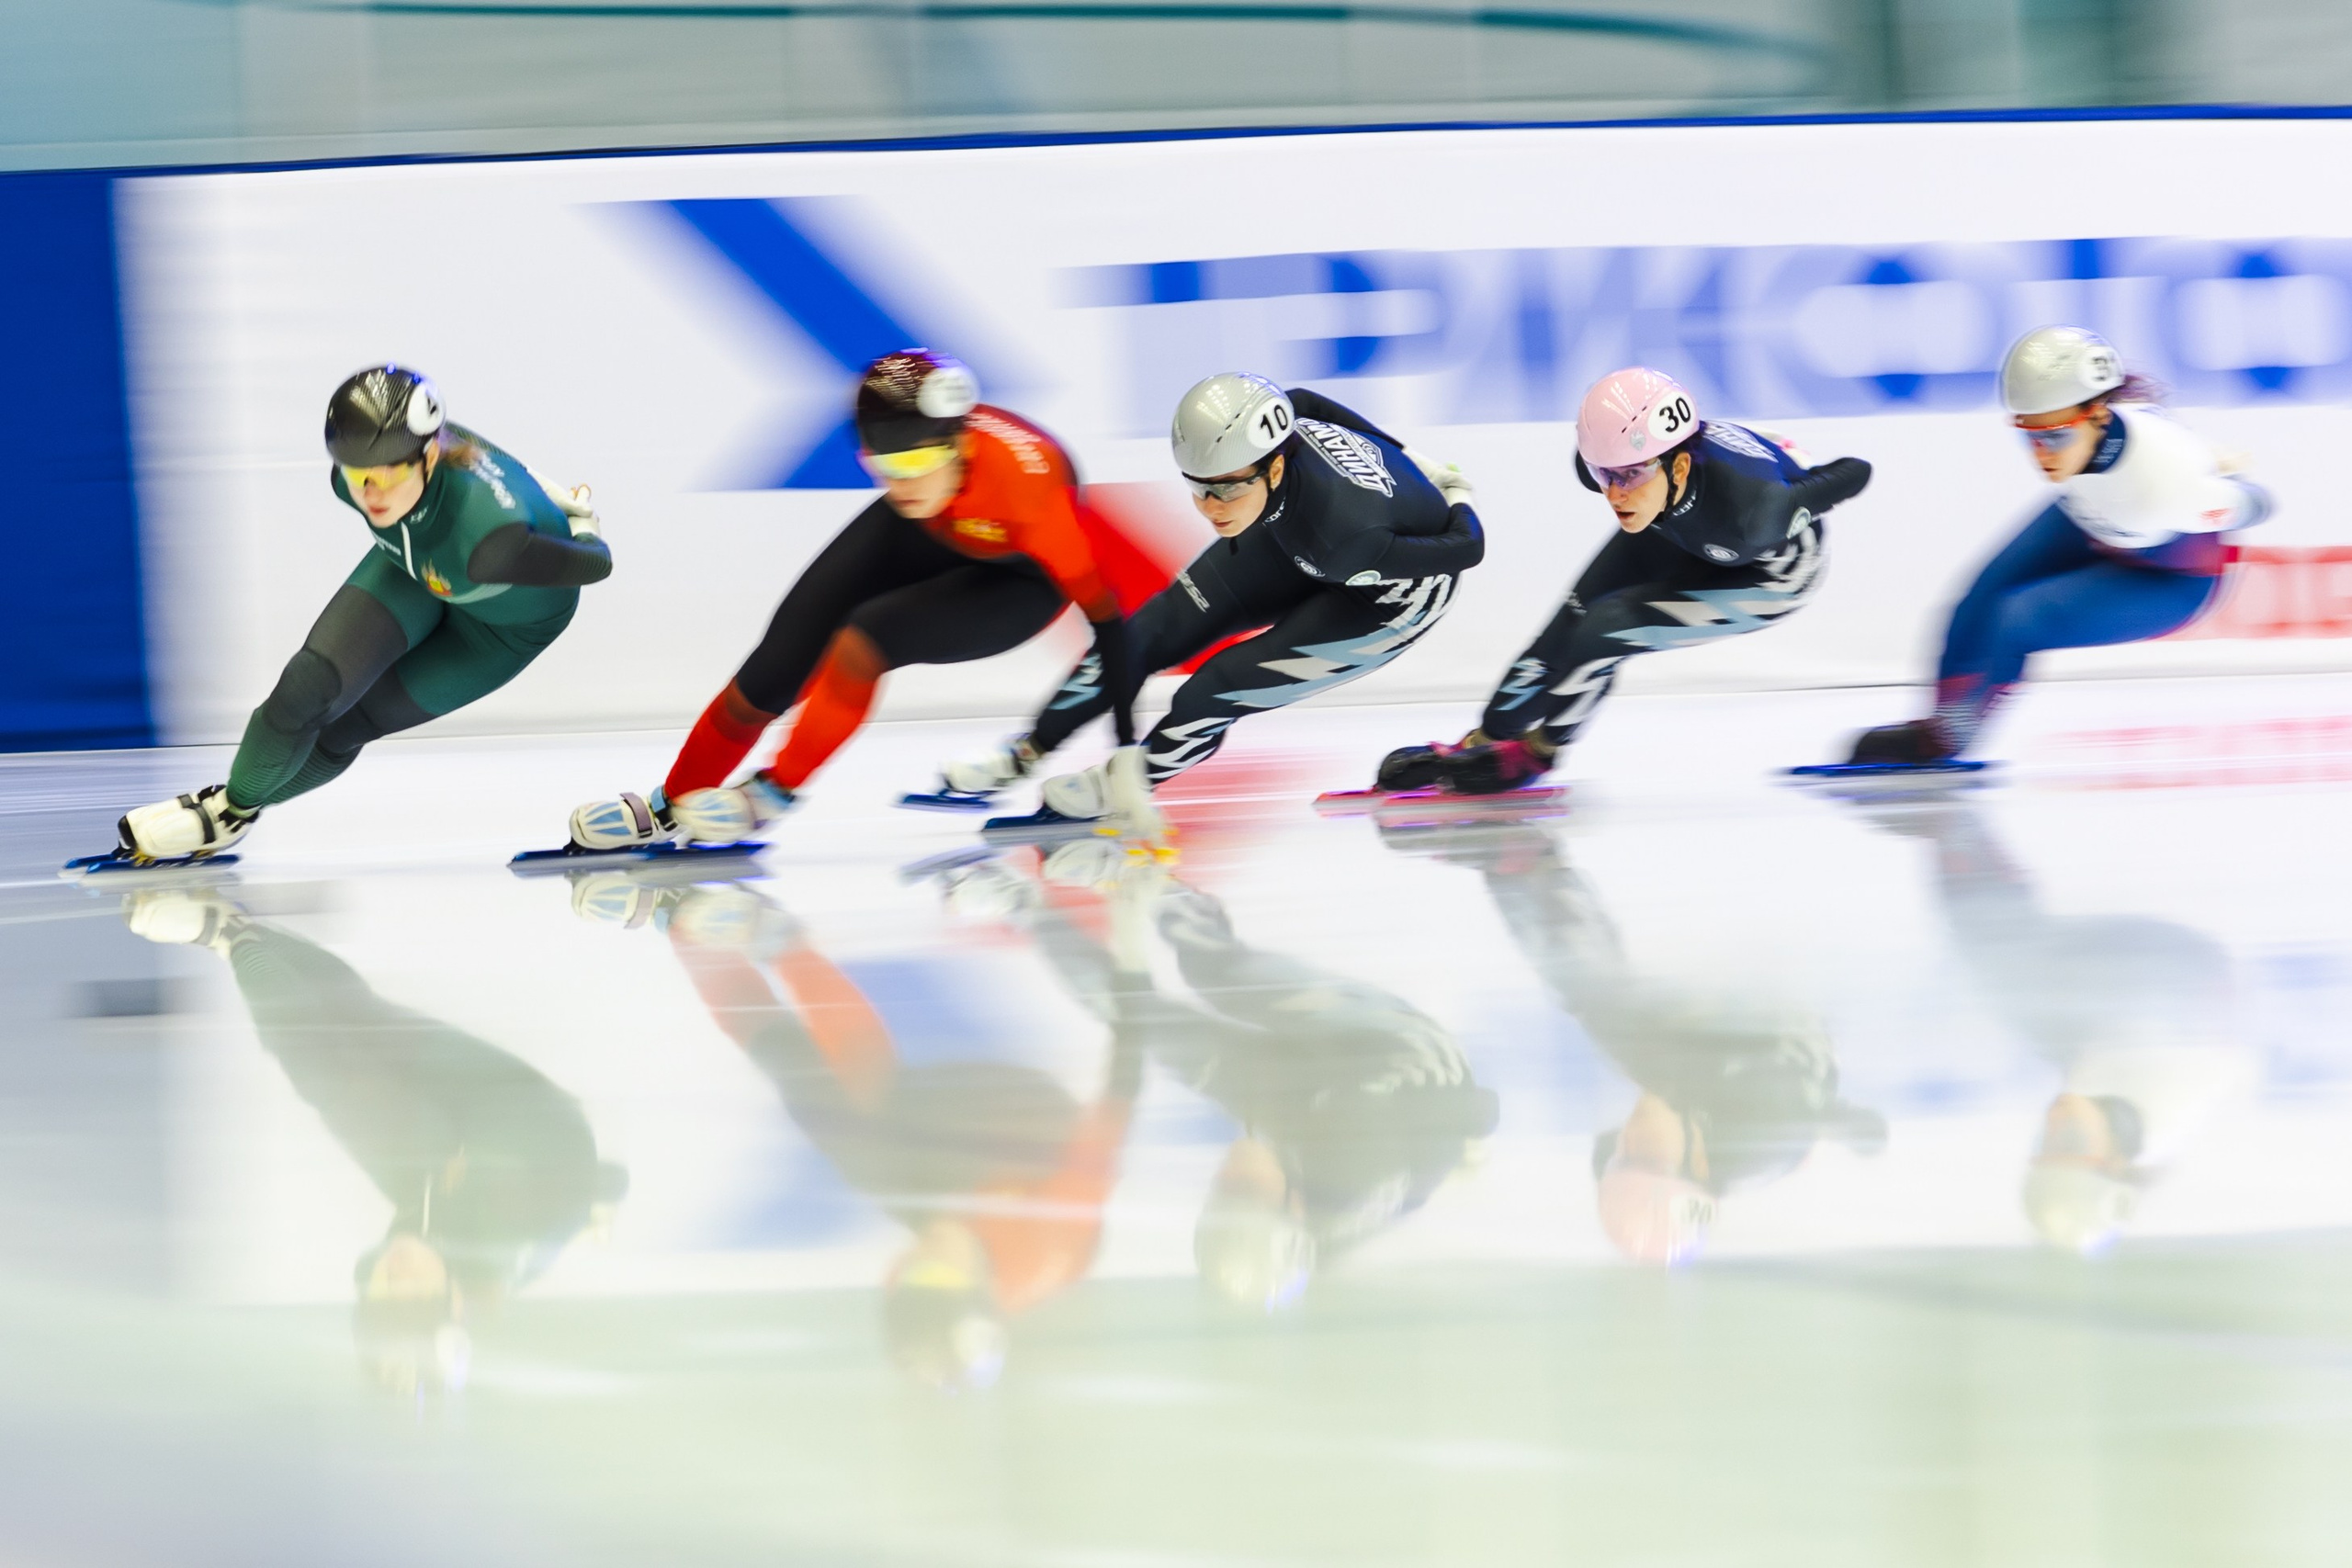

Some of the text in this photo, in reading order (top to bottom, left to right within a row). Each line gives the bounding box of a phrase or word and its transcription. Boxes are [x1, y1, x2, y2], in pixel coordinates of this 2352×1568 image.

[1260, 404, 1288, 439] 10
[1658, 397, 1691, 433] 30
[1295, 418, 1390, 494] ДИНАМО
